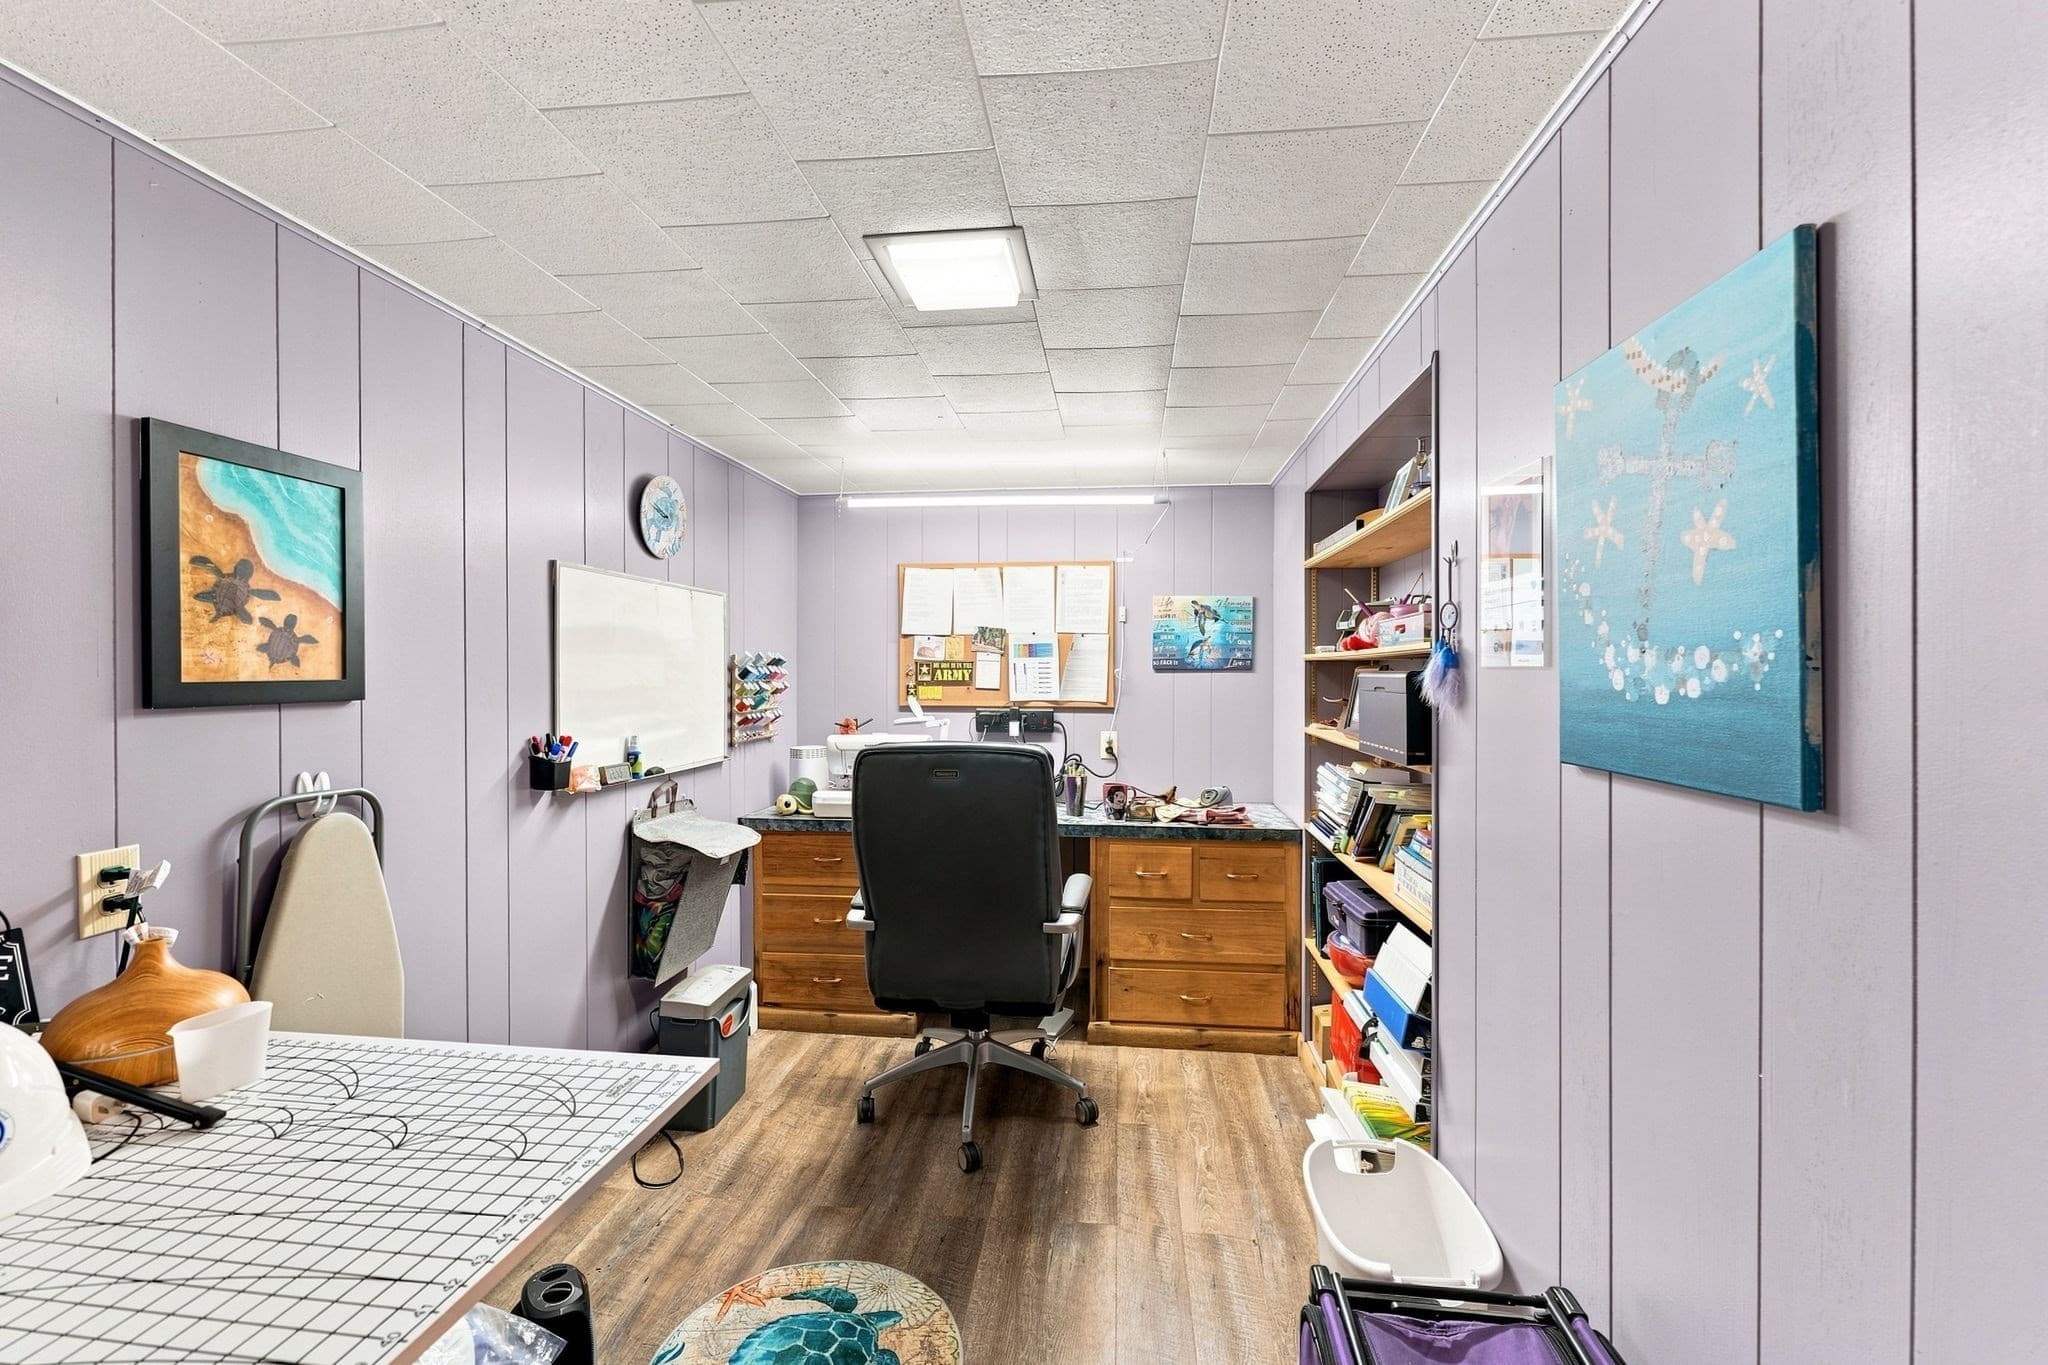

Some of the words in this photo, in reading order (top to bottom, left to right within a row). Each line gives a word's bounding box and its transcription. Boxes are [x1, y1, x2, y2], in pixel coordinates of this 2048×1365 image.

[933, 669, 973, 681] ARMY
[496, 1233, 513, 1245] 44
[471, 1254, 490, 1267] 43
[443, 1277, 463, 1292] 42
[414, 1304, 434, 1318] 41
[381, 1331, 402, 1348] 40
